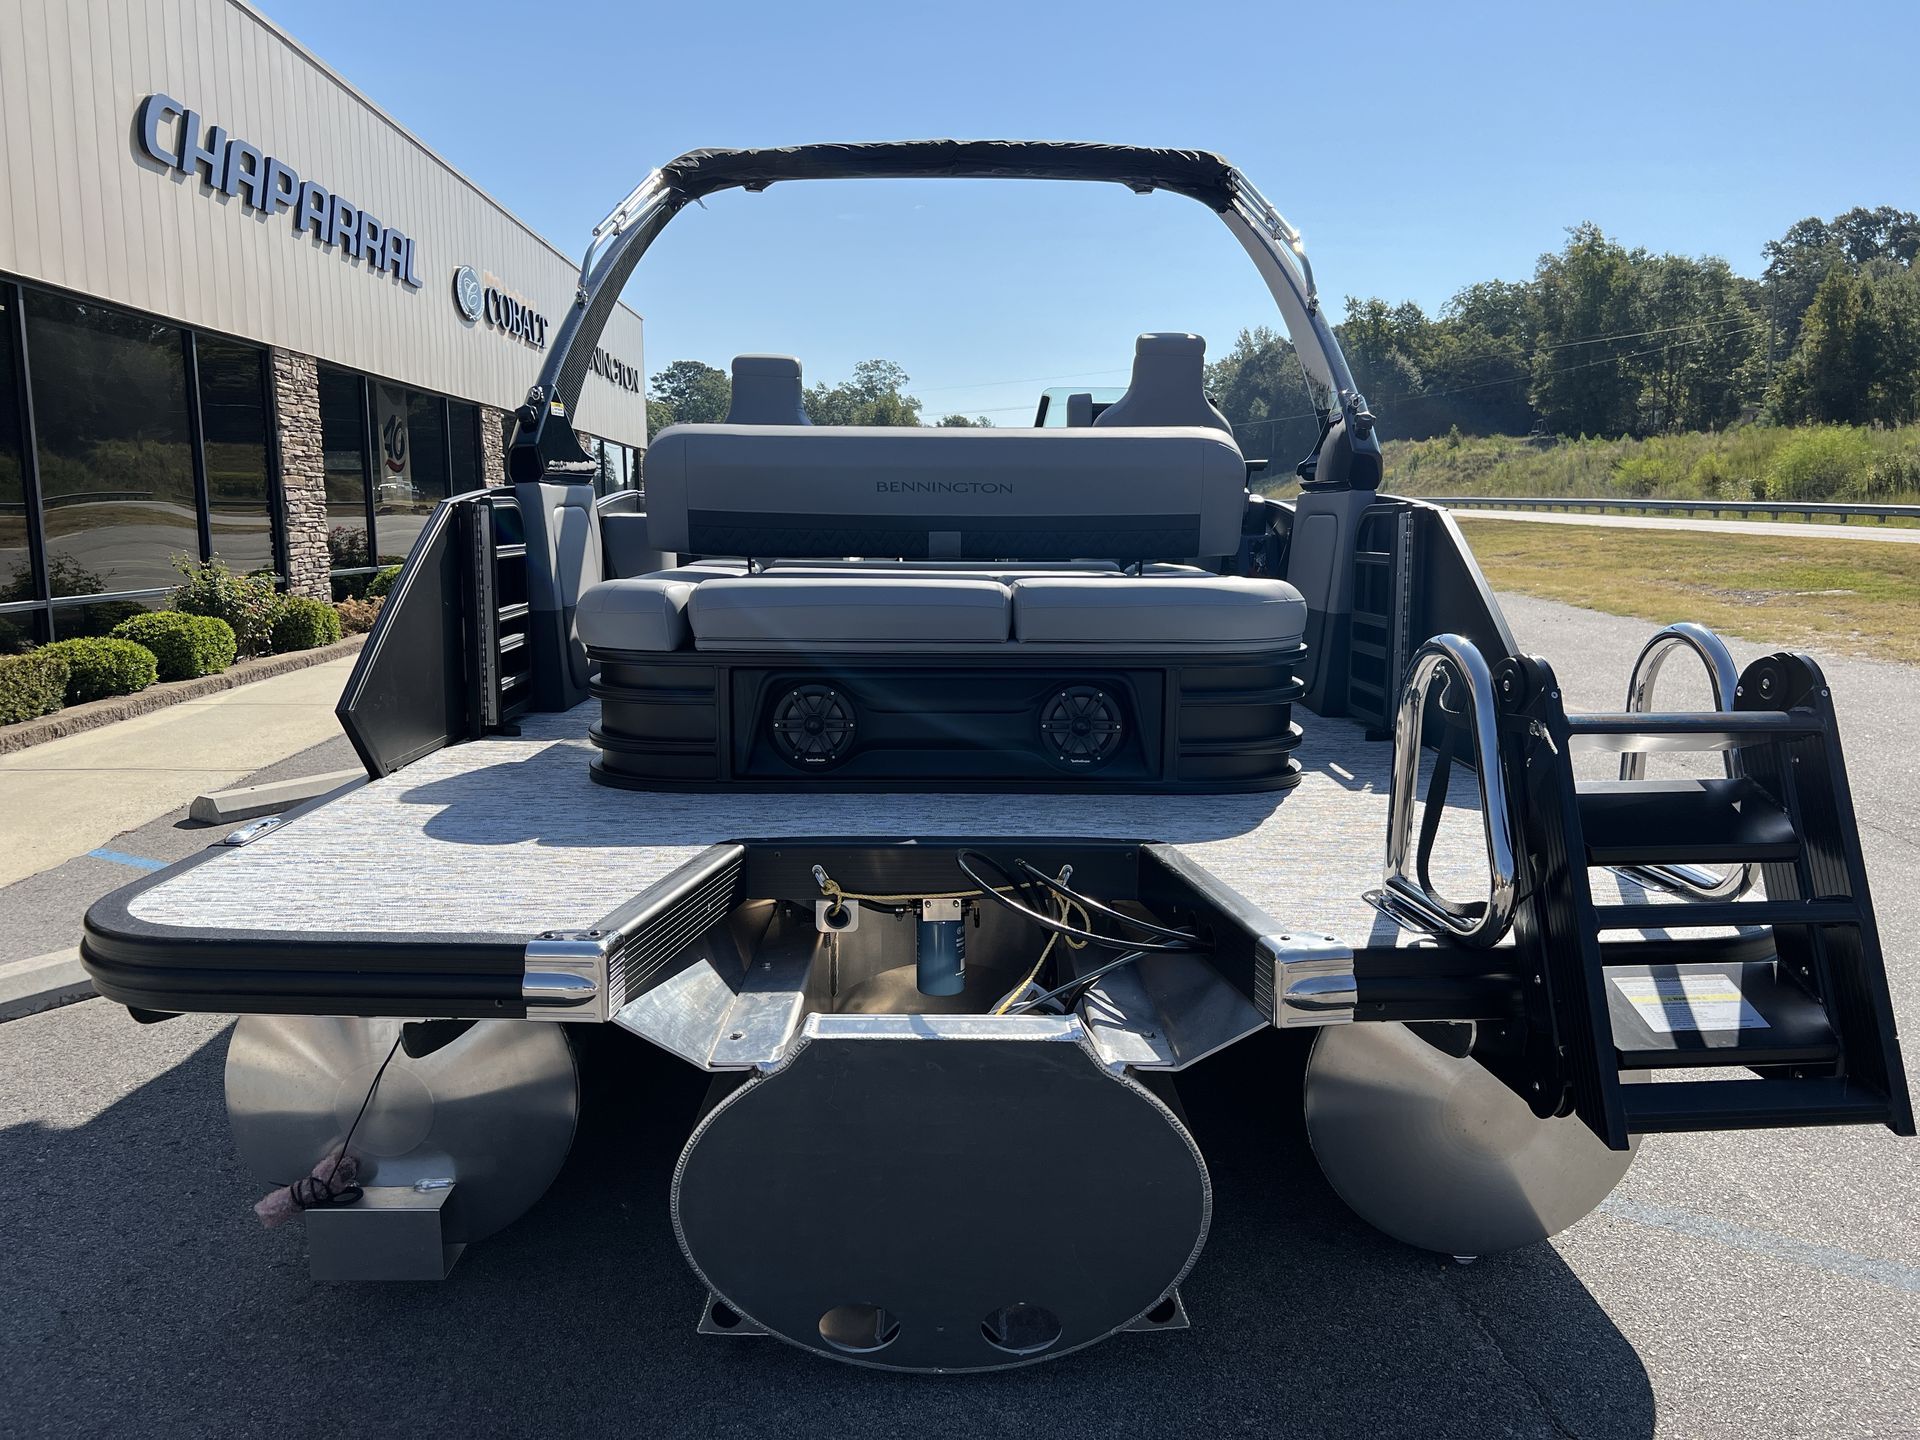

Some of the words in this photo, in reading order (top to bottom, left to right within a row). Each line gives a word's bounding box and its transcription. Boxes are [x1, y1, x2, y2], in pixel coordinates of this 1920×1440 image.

[137, 93, 423, 289] CHAPARRAL
[484, 286, 549, 349] COBALT
[875, 481, 1014, 495] BENNINGTON
